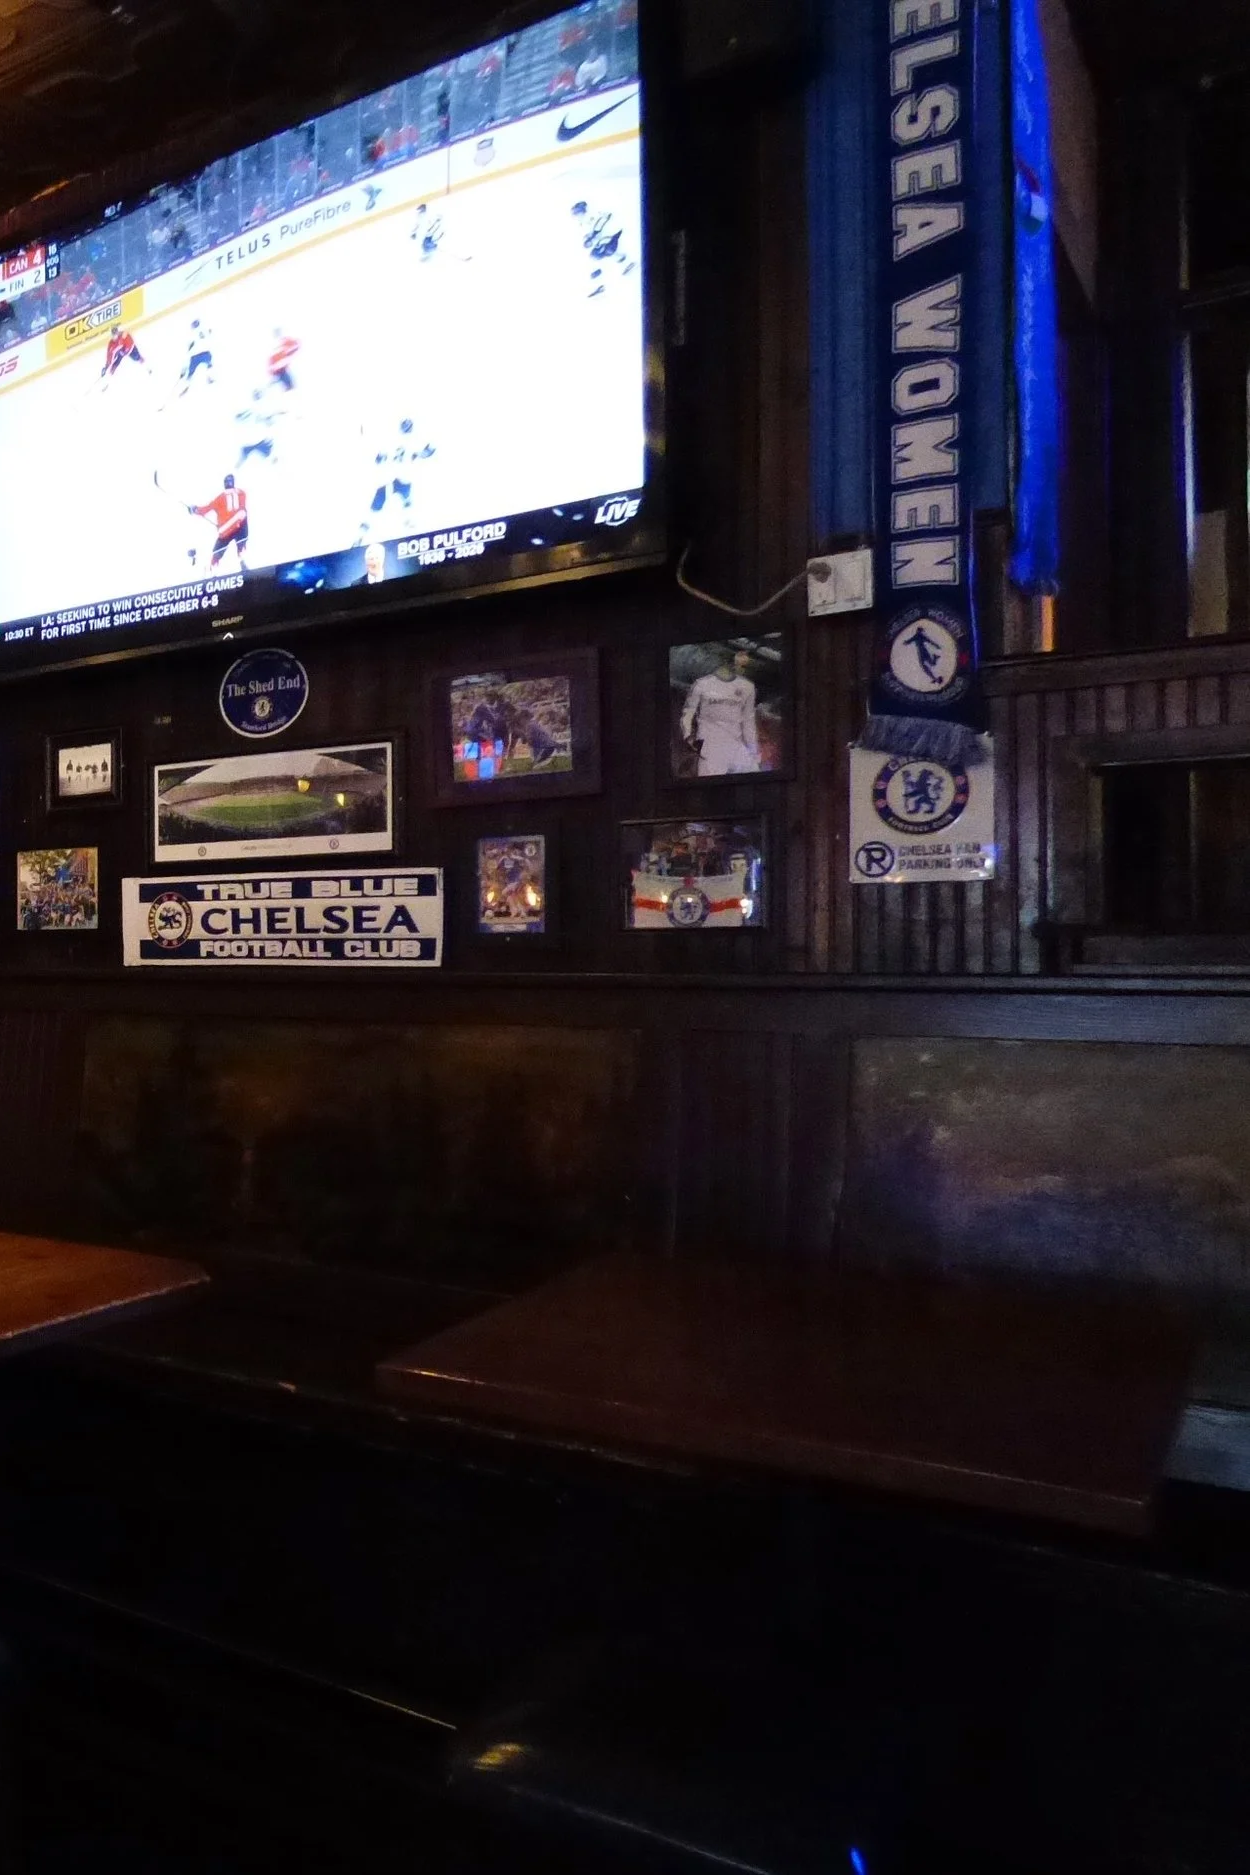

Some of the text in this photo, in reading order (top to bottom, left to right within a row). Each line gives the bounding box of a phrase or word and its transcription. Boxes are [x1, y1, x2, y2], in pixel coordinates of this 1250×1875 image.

[215, 200, 351, 269] TELUS PureFibre
[10, 248, 42, 275] CAN 4
[10, 270, 41, 293] FIN 2
[65, 313, 92, 341] OK
[96, 304, 119, 323] TIRE
[890, 273, 963, 588] WOMEN
[594, 498, 640, 526] LIVE
[397, 522, 507, 556] BOB PULFORD
[41, 575, 244, 628] LA: SEEKING TO WIN CONSECUTIVE GAMES
[41, 594, 219, 640] FOR FIRST TIME SINCE DECEMBER 6-8
[211, 615, 244, 628] SHARP
[25, 626, 34, 638] ET
[226, 673, 301, 699] The Shed End
[197, 877, 419, 901] TRUE BLUE
[200, 904, 420, 935] CHELSEA
[199, 938, 422, 959] FOOTBALL CLUB
